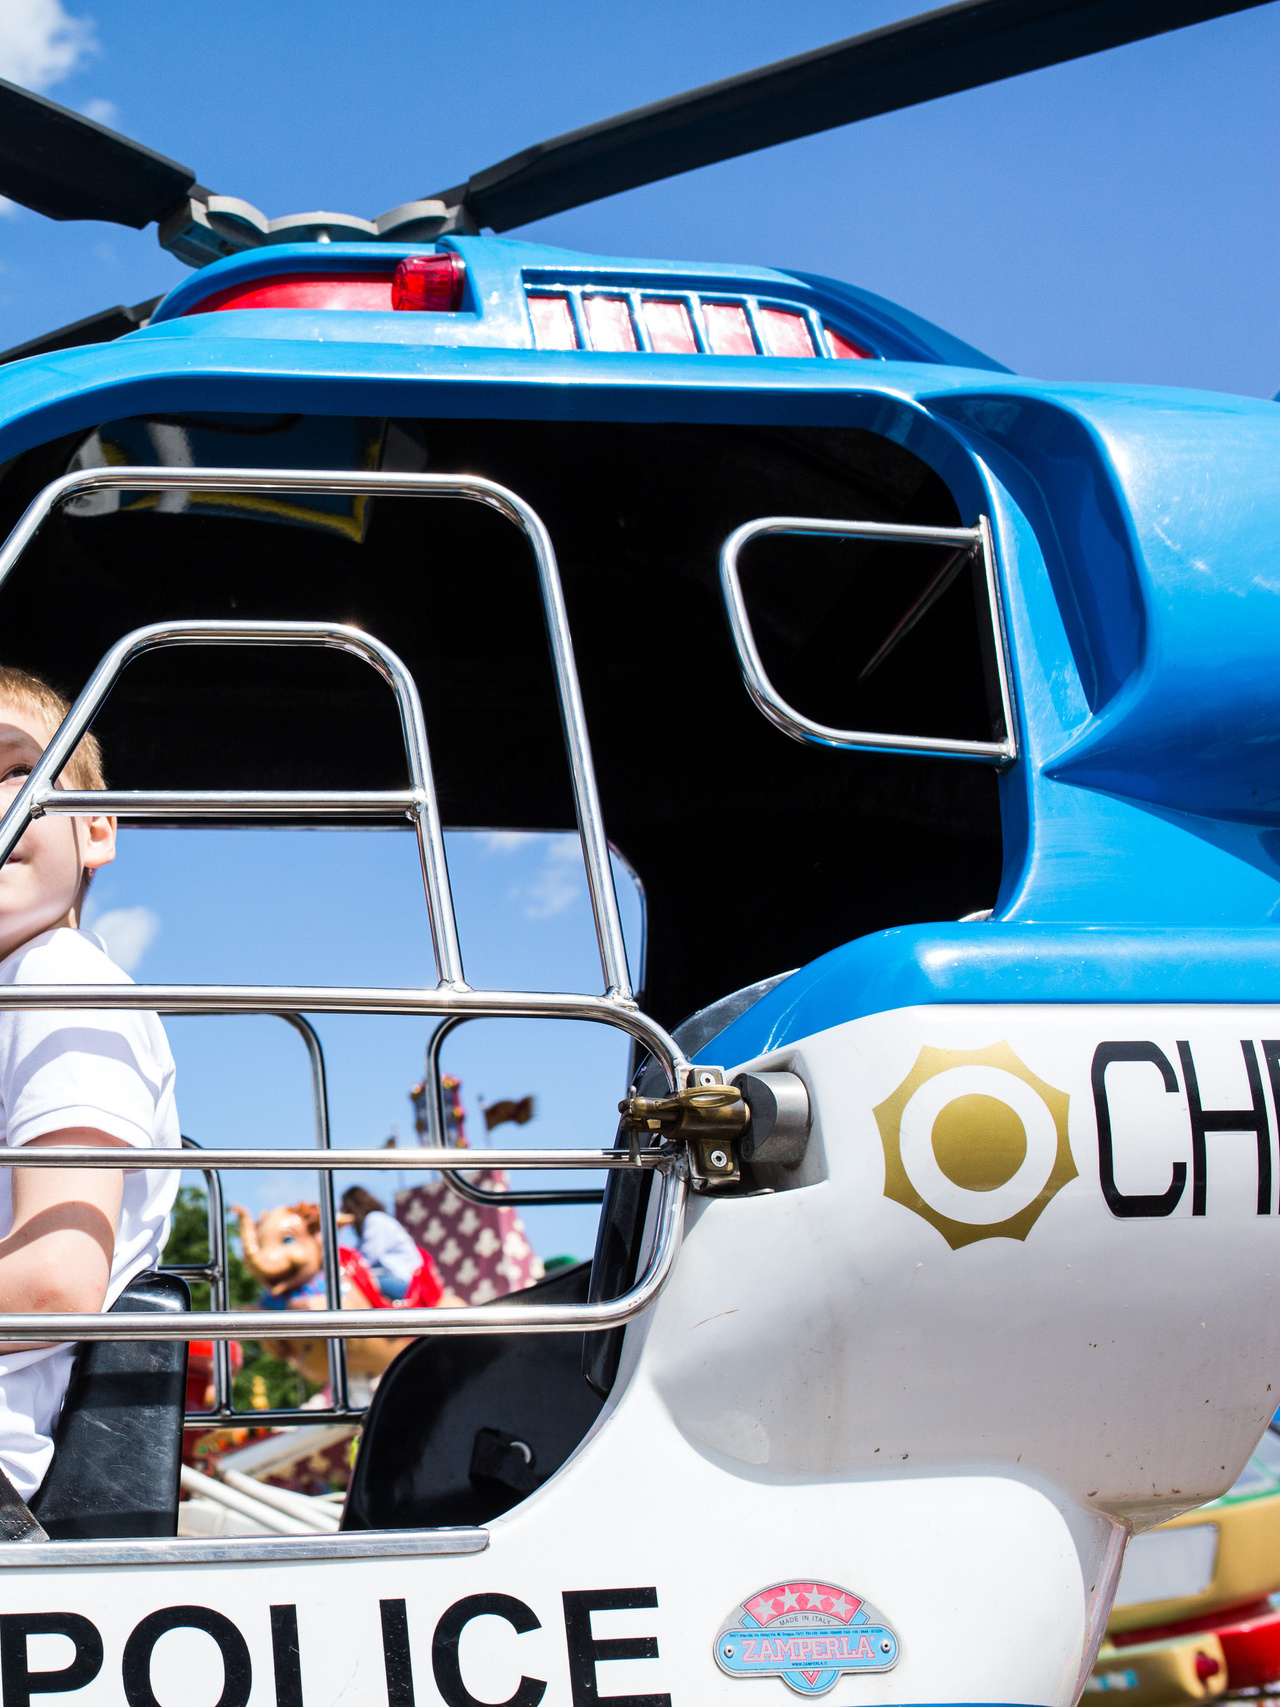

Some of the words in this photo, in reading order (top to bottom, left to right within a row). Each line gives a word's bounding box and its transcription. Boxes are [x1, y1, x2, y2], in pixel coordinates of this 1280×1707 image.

[1091, 1040, 1280, 1217] CH
[779, 1615, 799, 1626] MADE
[812, 1615, 832, 1625] ITALY
[741, 1635, 876, 1663] ZAMPERLA
